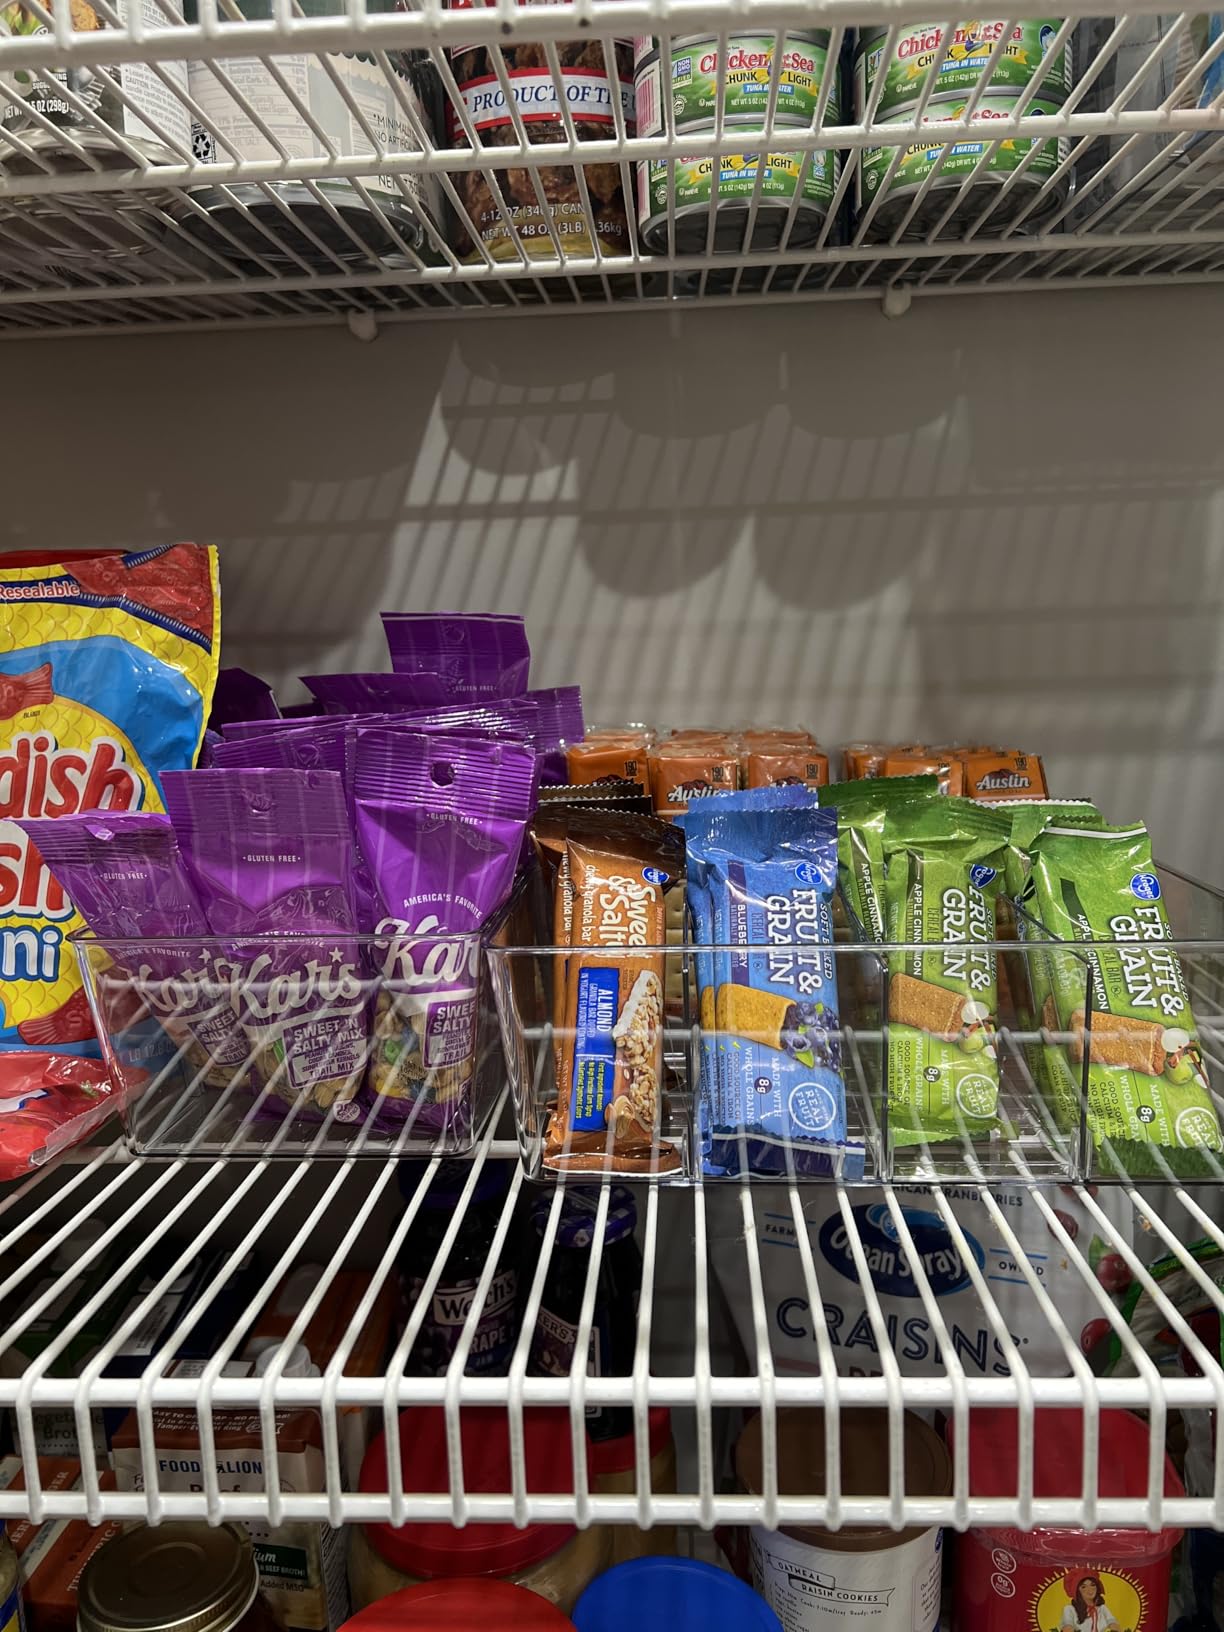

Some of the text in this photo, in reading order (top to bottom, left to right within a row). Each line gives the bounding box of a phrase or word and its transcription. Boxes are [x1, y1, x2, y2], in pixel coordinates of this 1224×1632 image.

[791, 52, 815, 73] Sea
[746, 84, 763, 92] TUNA
[787, 71, 812, 88] LIGHT
[566, 85, 591, 103] OF
[594, 86, 628, 107] TE
[956, 145, 980, 153] WATER
[722, 171, 739, 180] TUNA
[521, 224, 536, 236] 48
[558, 221, 585, 234] (3LB)
[976, 773, 1031, 791] Austin
[430, 813, 480, 825] GLUTEN FREE
[247, 855, 297, 863] GLUTEN FREE
[103, 872, 146, 881] GLUTEN FREE
[861, 863, 874, 895] APPLE
[403, 893, 484, 920] AMERICA'S FAVORITE
[580, 891, 597, 942] granola bar
[819, 903, 832, 938] SOFT
[866, 896, 884, 944] CINNAMO
[913, 882, 922, 976] APPLE CINNMON
[737, 904, 748, 969] BLUEBERY
[766, 895, 795, 985] GRAIN
[943, 888, 967, 981] GRAIN
[798, 971, 823, 994] &
[970, 969, 991, 992] &
[1087, 950, 1110, 1011] CINNAMON
[1106, 967, 1122, 984] BAR
[1172, 958, 1190, 1002] BAKED
[437, 1000, 476, 1020] SWEE
[596, 988, 614, 1032] ALMOND
[1160, 992, 1186, 1017] &
[293, 1020, 340, 1041] SWEET
[433, 1014, 473, 1034] SALTY
[293, 1027, 364, 1054] SALTY MIX
[336, 1061, 354, 1072] MIX
[926, 1067, 939, 1082] 8g
[744, 1046, 755, 1125] WHOLE GRAINS
[756, 1078, 770, 1094] 8g
[942, 1078, 950, 1105] WITH
[1089, 1083, 1098, 1097] NO
[1107, 1080, 1119, 1105] GOOD
[1119, 1074, 1135, 1113] WHOLE
[773, 1089, 783, 1118] WITH
[795, 1091, 815, 1126] FRUIT
[805, 1089, 824, 1124] REAL
[1099, 1081, 1114, 1120] CALCIUM
[1140, 1107, 1153, 1123] 8g
[1149, 1084, 1170, 1147] MADE WITH
[766, 1224, 795, 1237] FARM
[473, 1325, 508, 1353] RAPE
[158, 1460, 263, 1474] FOOD LION
[778, 1562, 822, 1583] OATMEAL
[801, 1584, 879, 1602] RAISIN COOKIES
